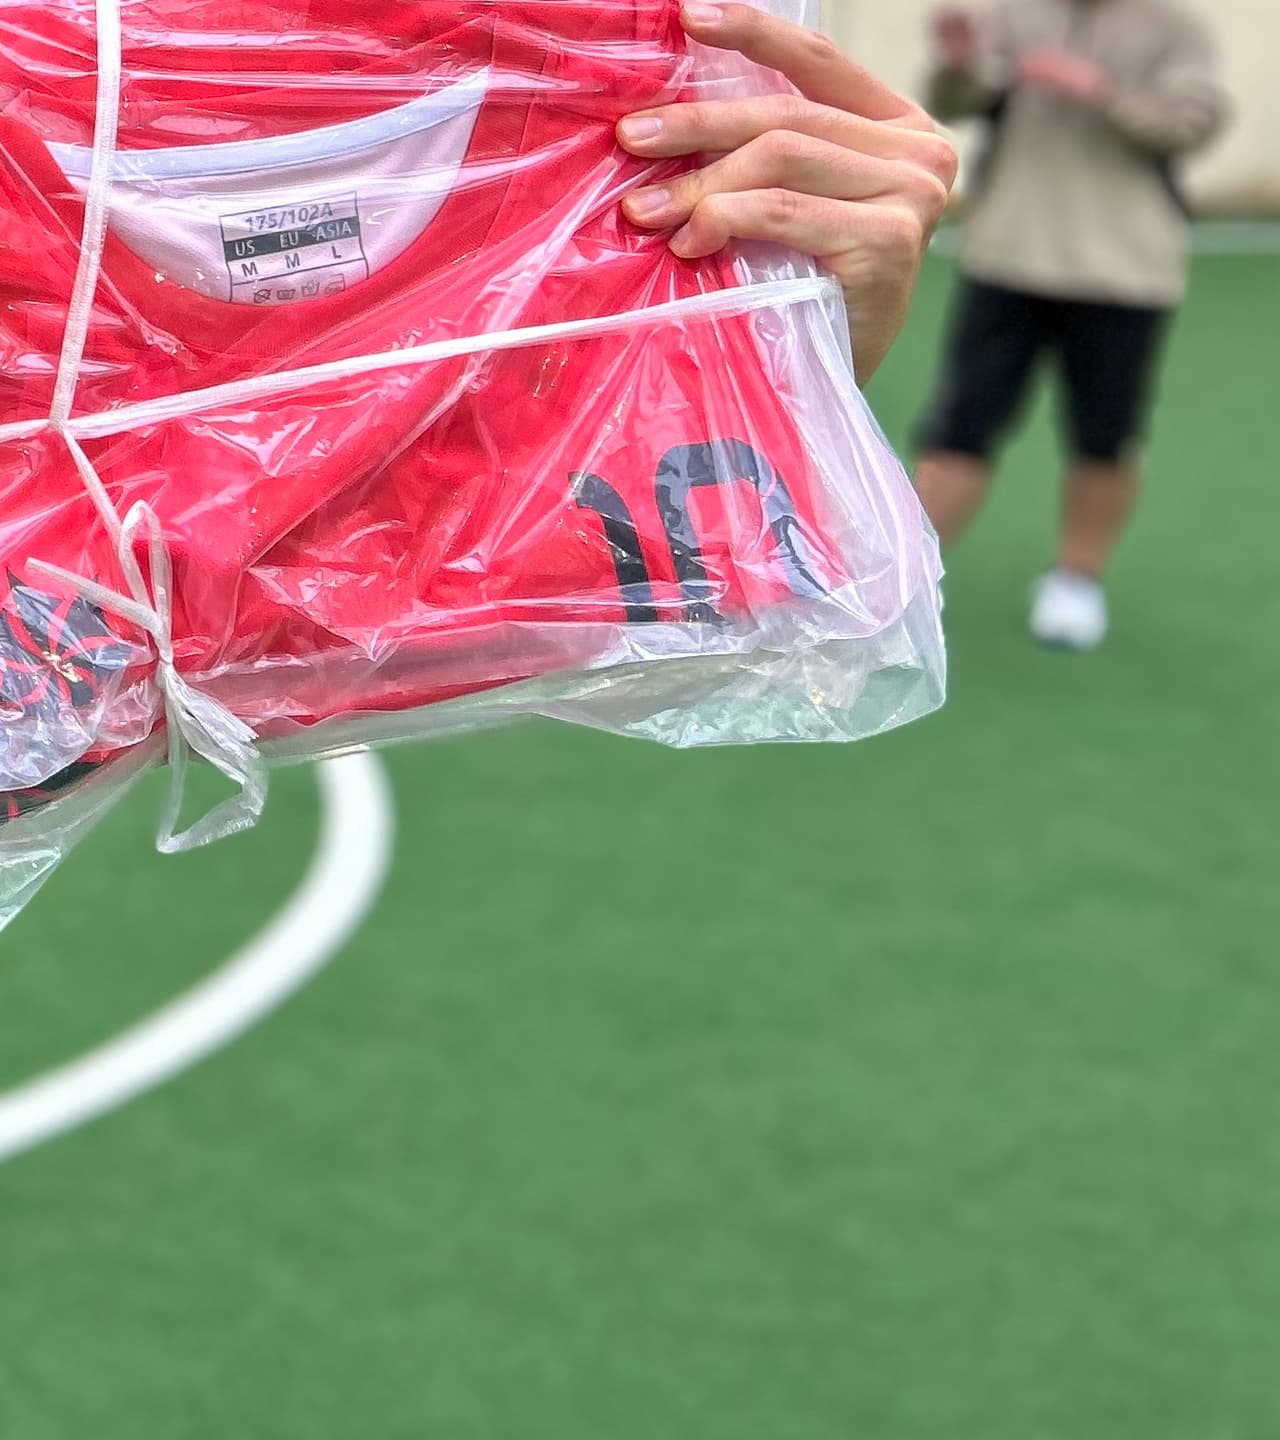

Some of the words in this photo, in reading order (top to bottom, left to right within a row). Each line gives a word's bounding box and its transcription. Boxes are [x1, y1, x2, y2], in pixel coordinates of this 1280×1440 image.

[244, 202, 333, 232] 175/102A
[234, 240, 256, 256] US
[279, 232, 299, 249] EU
[315, 221, 353, 241] ASIA
[241, 261, 258, 278] M
[285, 253, 301, 269] M
[331, 246, 342, 259] L
